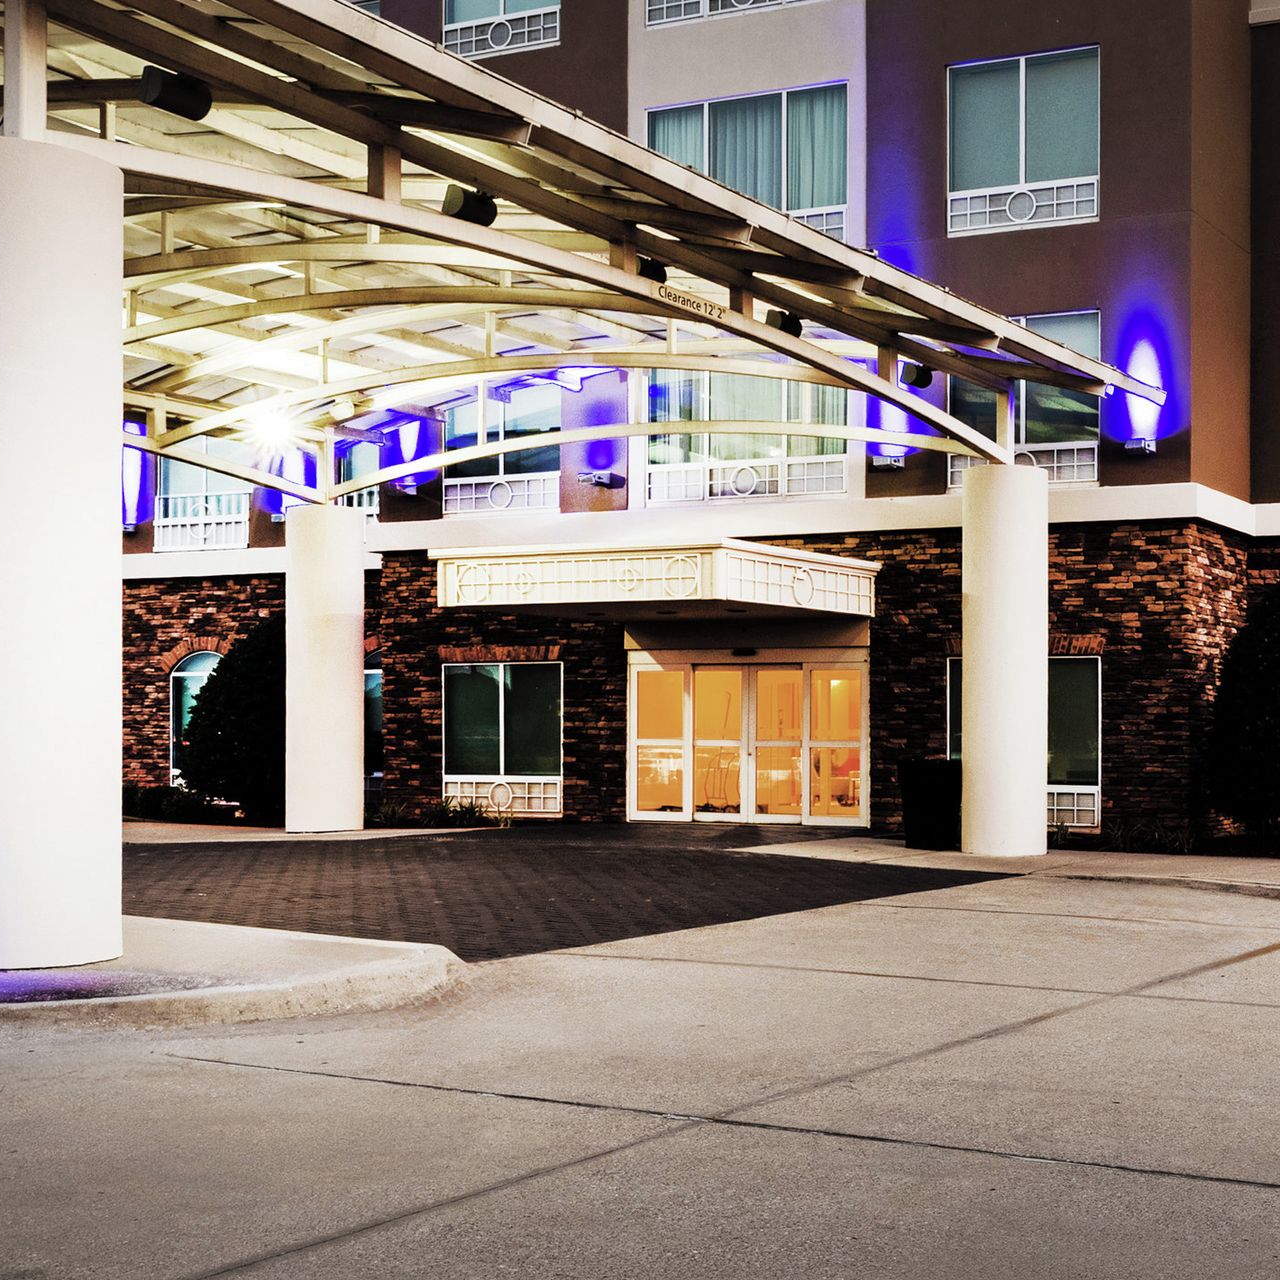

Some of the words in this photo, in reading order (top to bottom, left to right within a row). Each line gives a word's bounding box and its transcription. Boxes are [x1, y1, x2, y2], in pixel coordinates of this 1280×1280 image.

[658, 285, 702, 312] Clearance
[703, 302, 716, 317] 12'
[717, 307, 727, 320] 2"
